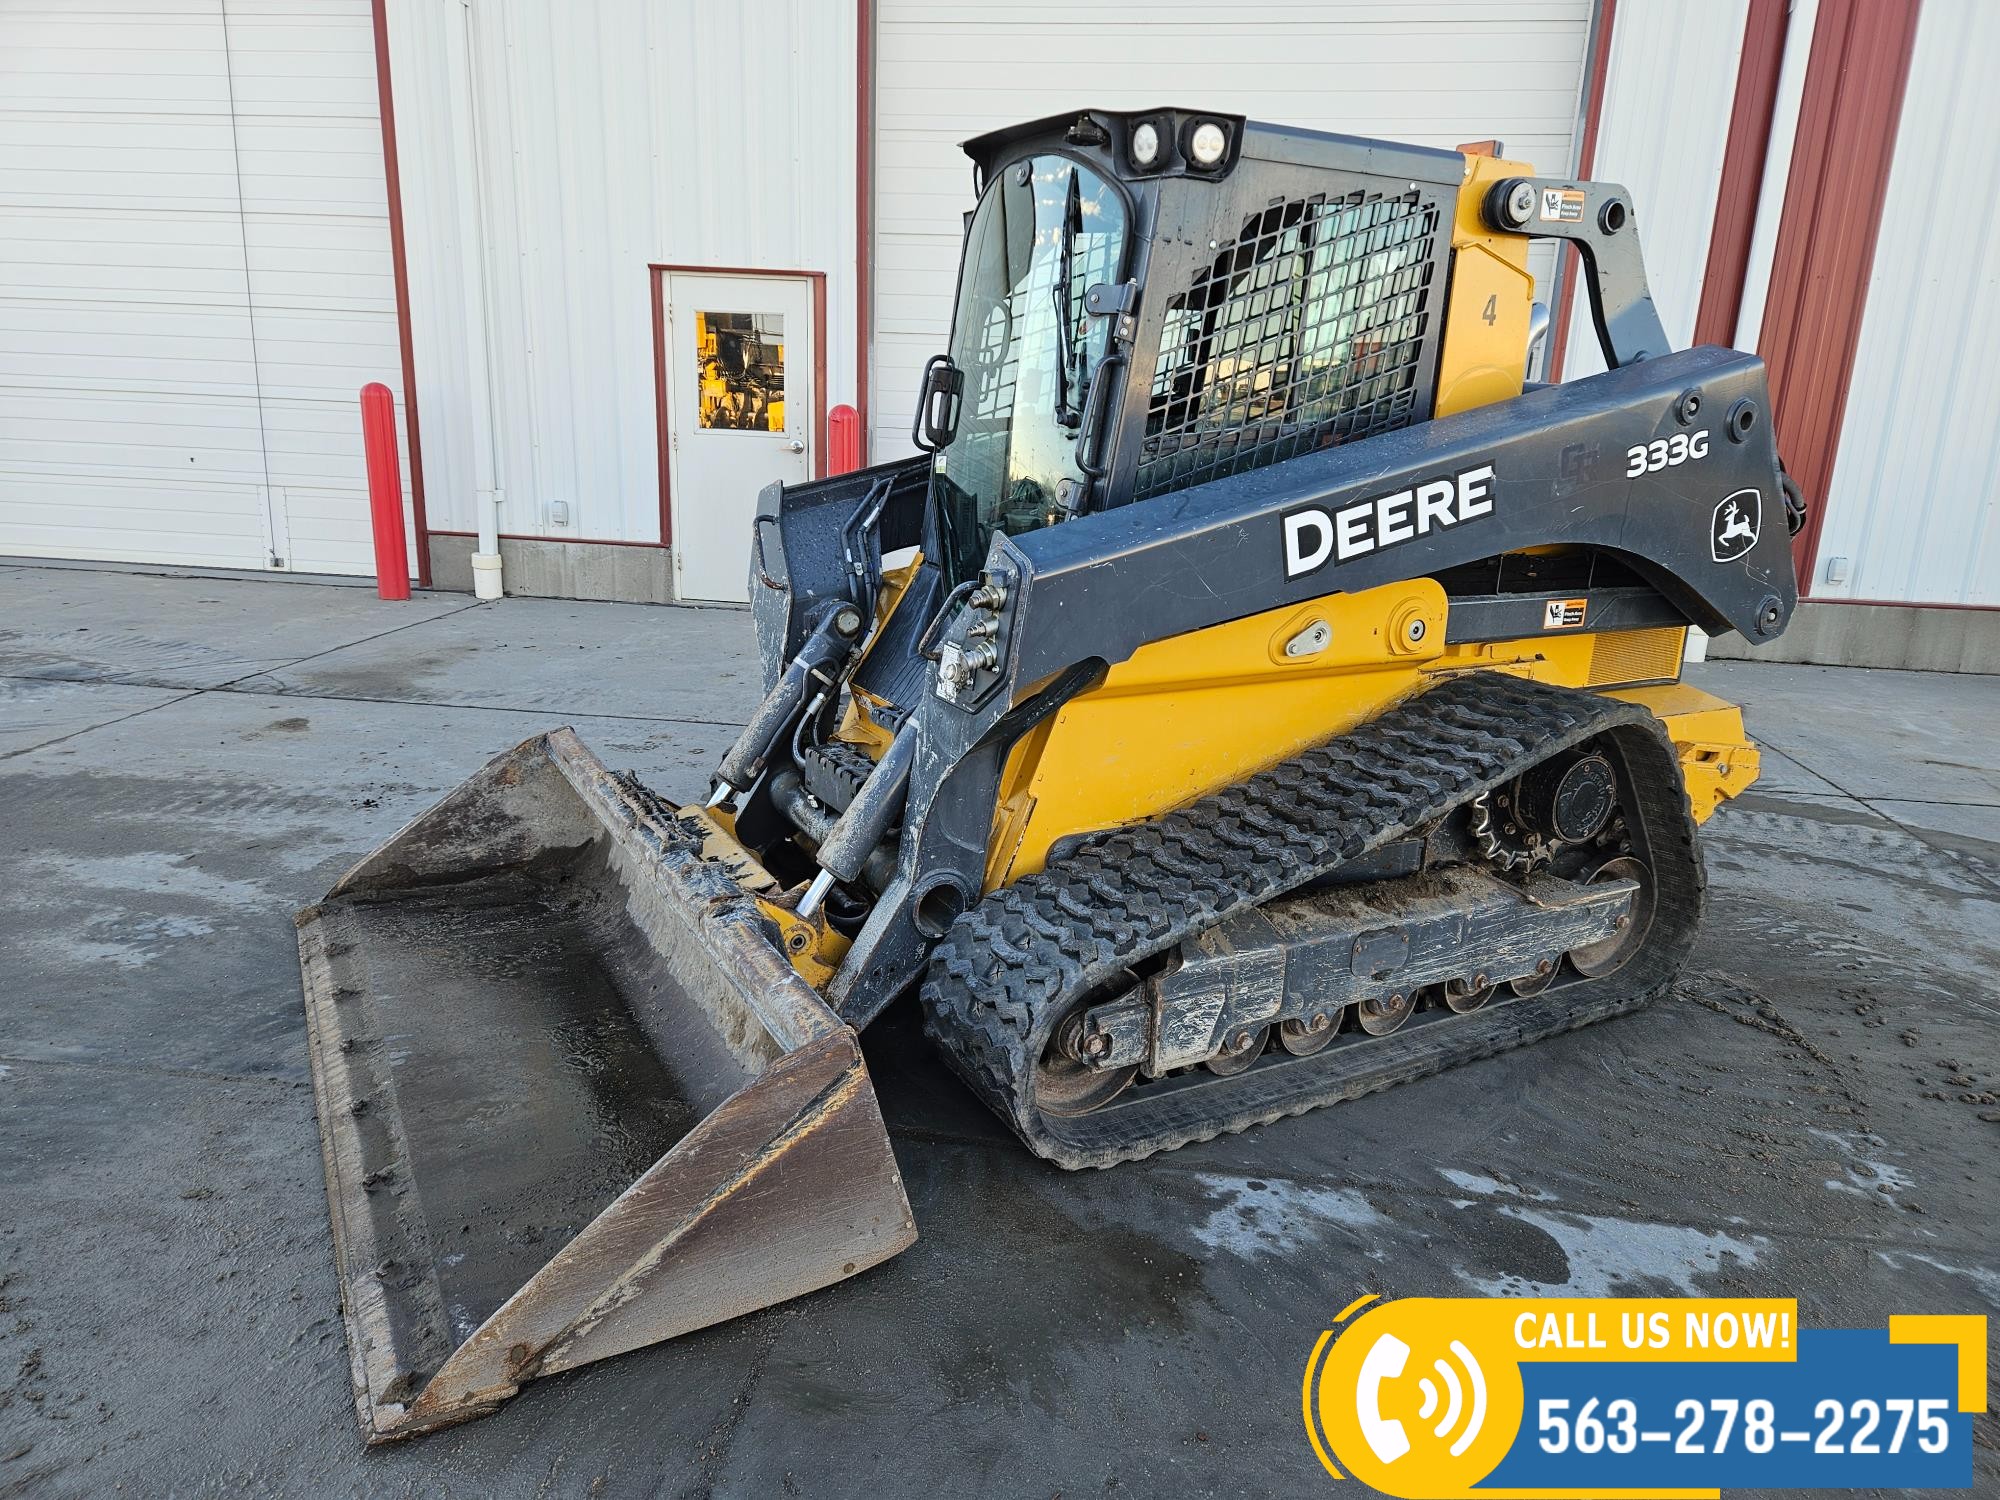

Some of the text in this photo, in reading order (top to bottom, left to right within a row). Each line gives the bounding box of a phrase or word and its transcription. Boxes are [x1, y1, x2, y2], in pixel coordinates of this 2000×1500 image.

[1482, 294, 1497, 327] 4
[1626, 429, 1709, 478] 333G
[1284, 465, 1494, 577] DEERE
